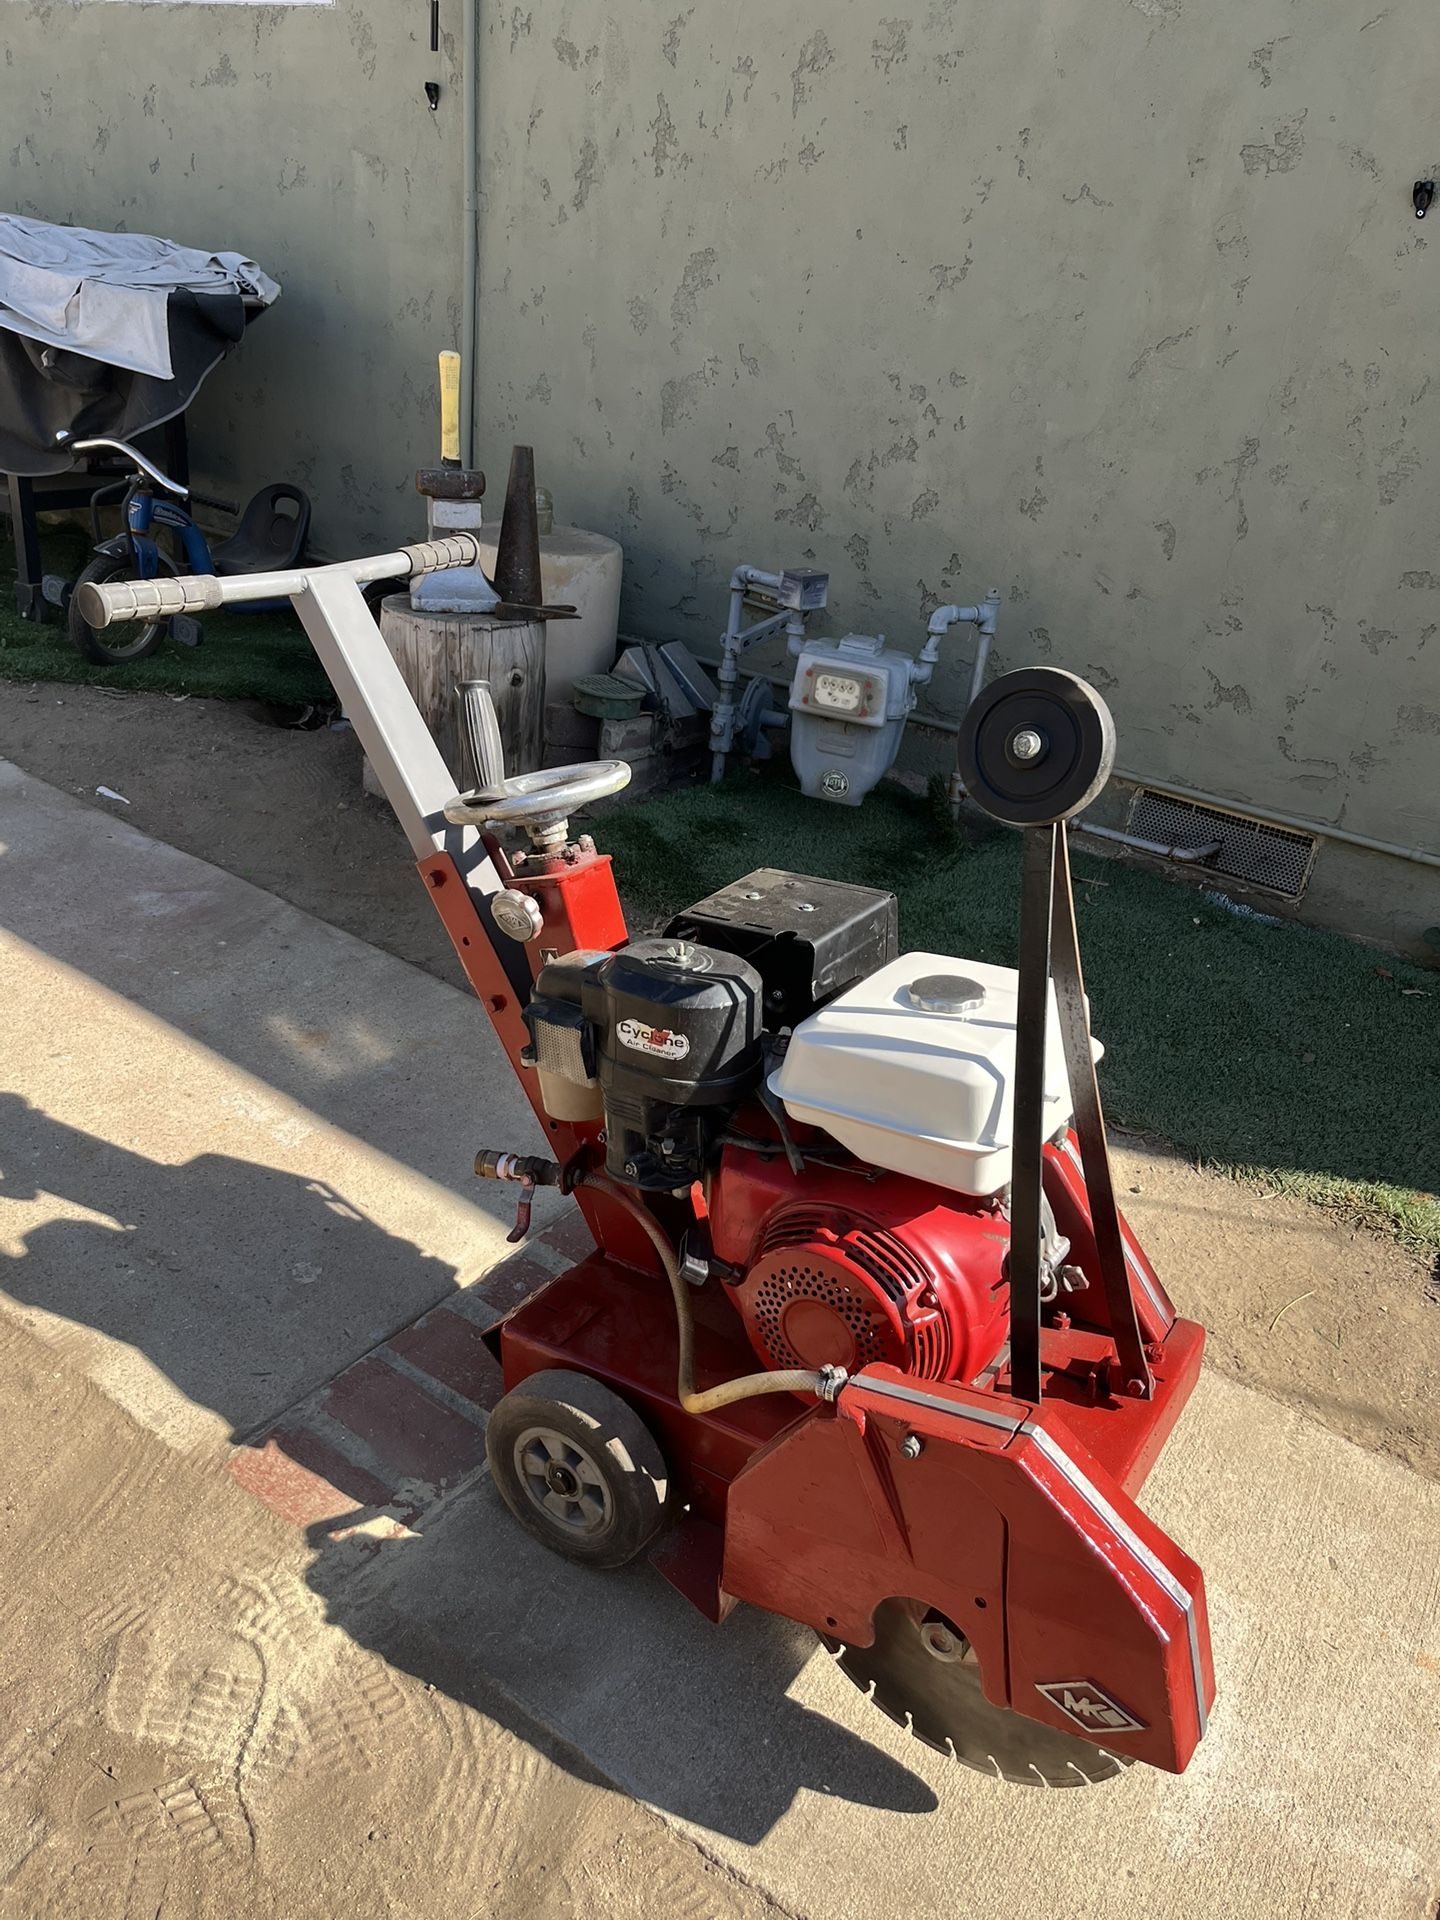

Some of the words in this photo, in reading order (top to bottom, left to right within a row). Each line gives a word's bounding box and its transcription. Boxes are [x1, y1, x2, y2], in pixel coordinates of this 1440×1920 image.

[620, 1022, 684, 1047] Cyclone
[627, 1038, 640, 1046] Air
[642, 1043, 676, 1056] Cleaner
